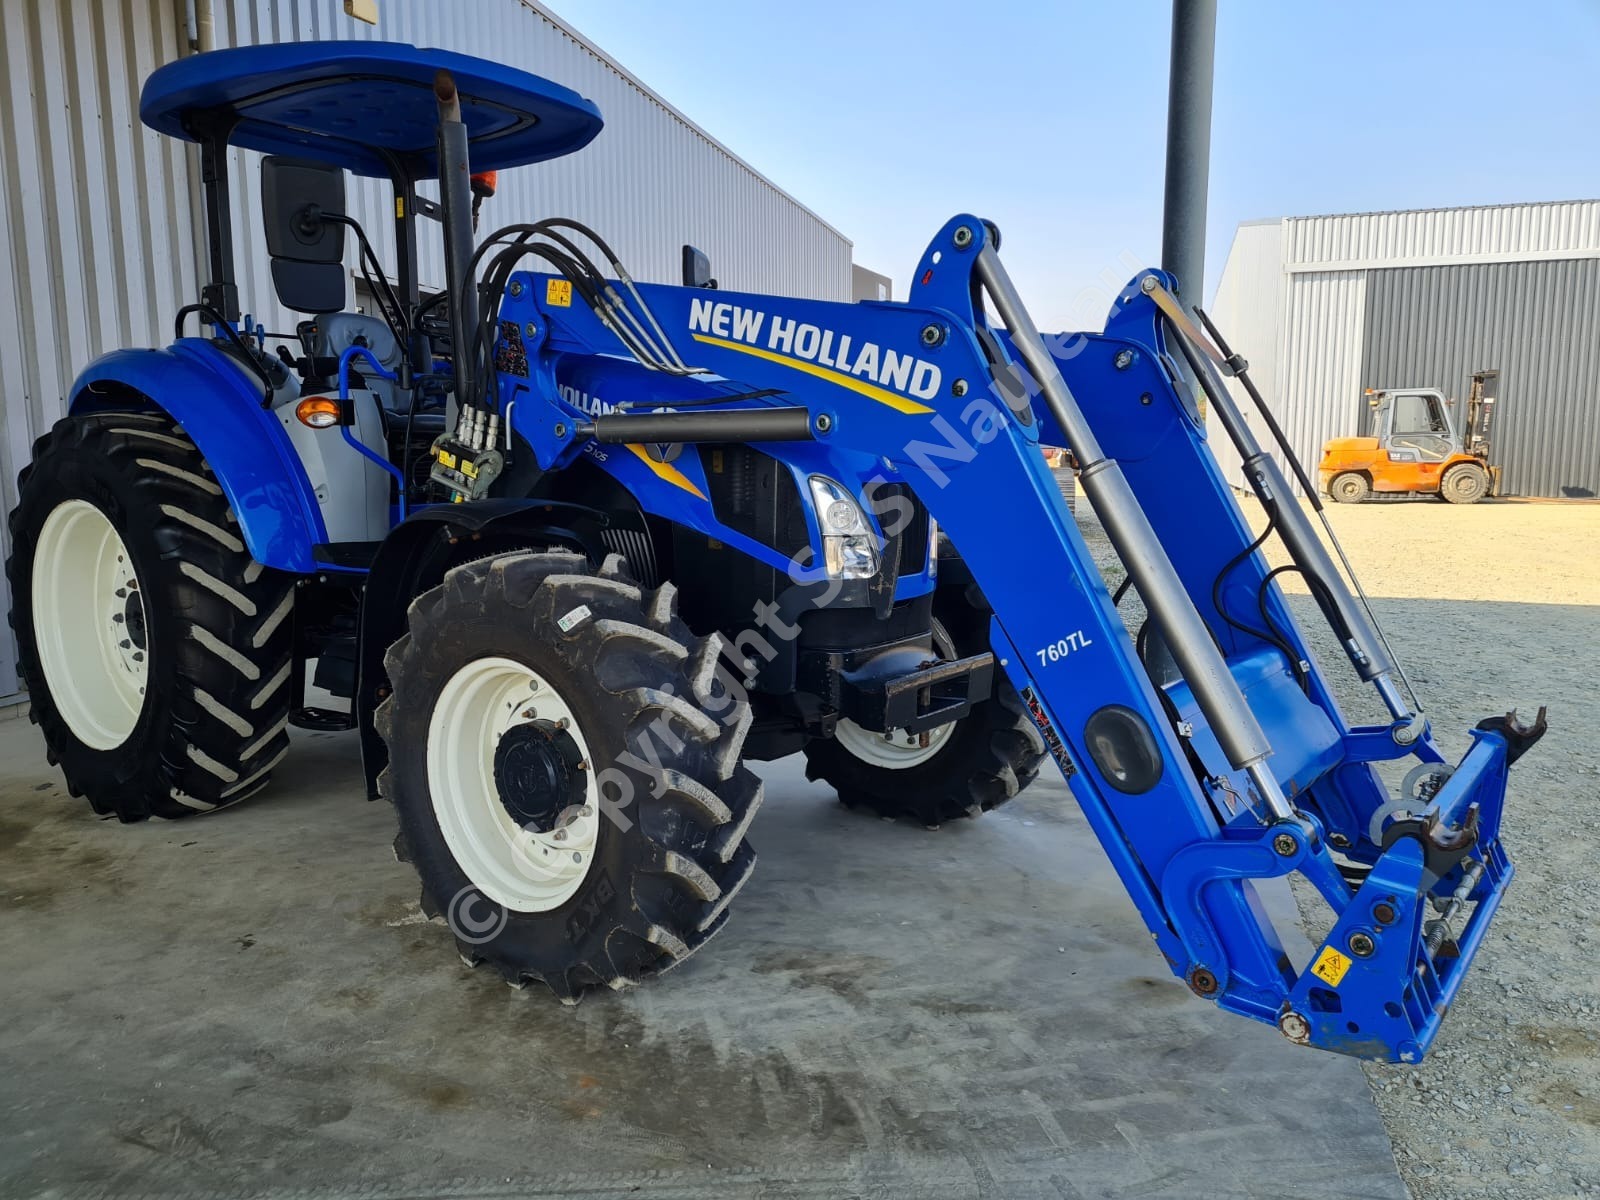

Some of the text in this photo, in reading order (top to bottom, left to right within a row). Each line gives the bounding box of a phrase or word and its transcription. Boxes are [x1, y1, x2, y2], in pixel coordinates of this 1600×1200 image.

[689, 298, 942, 400] NEW HOLLAND
[558, 383, 627, 417] OLLAN
[1037, 630, 1092, 667] 760TL
